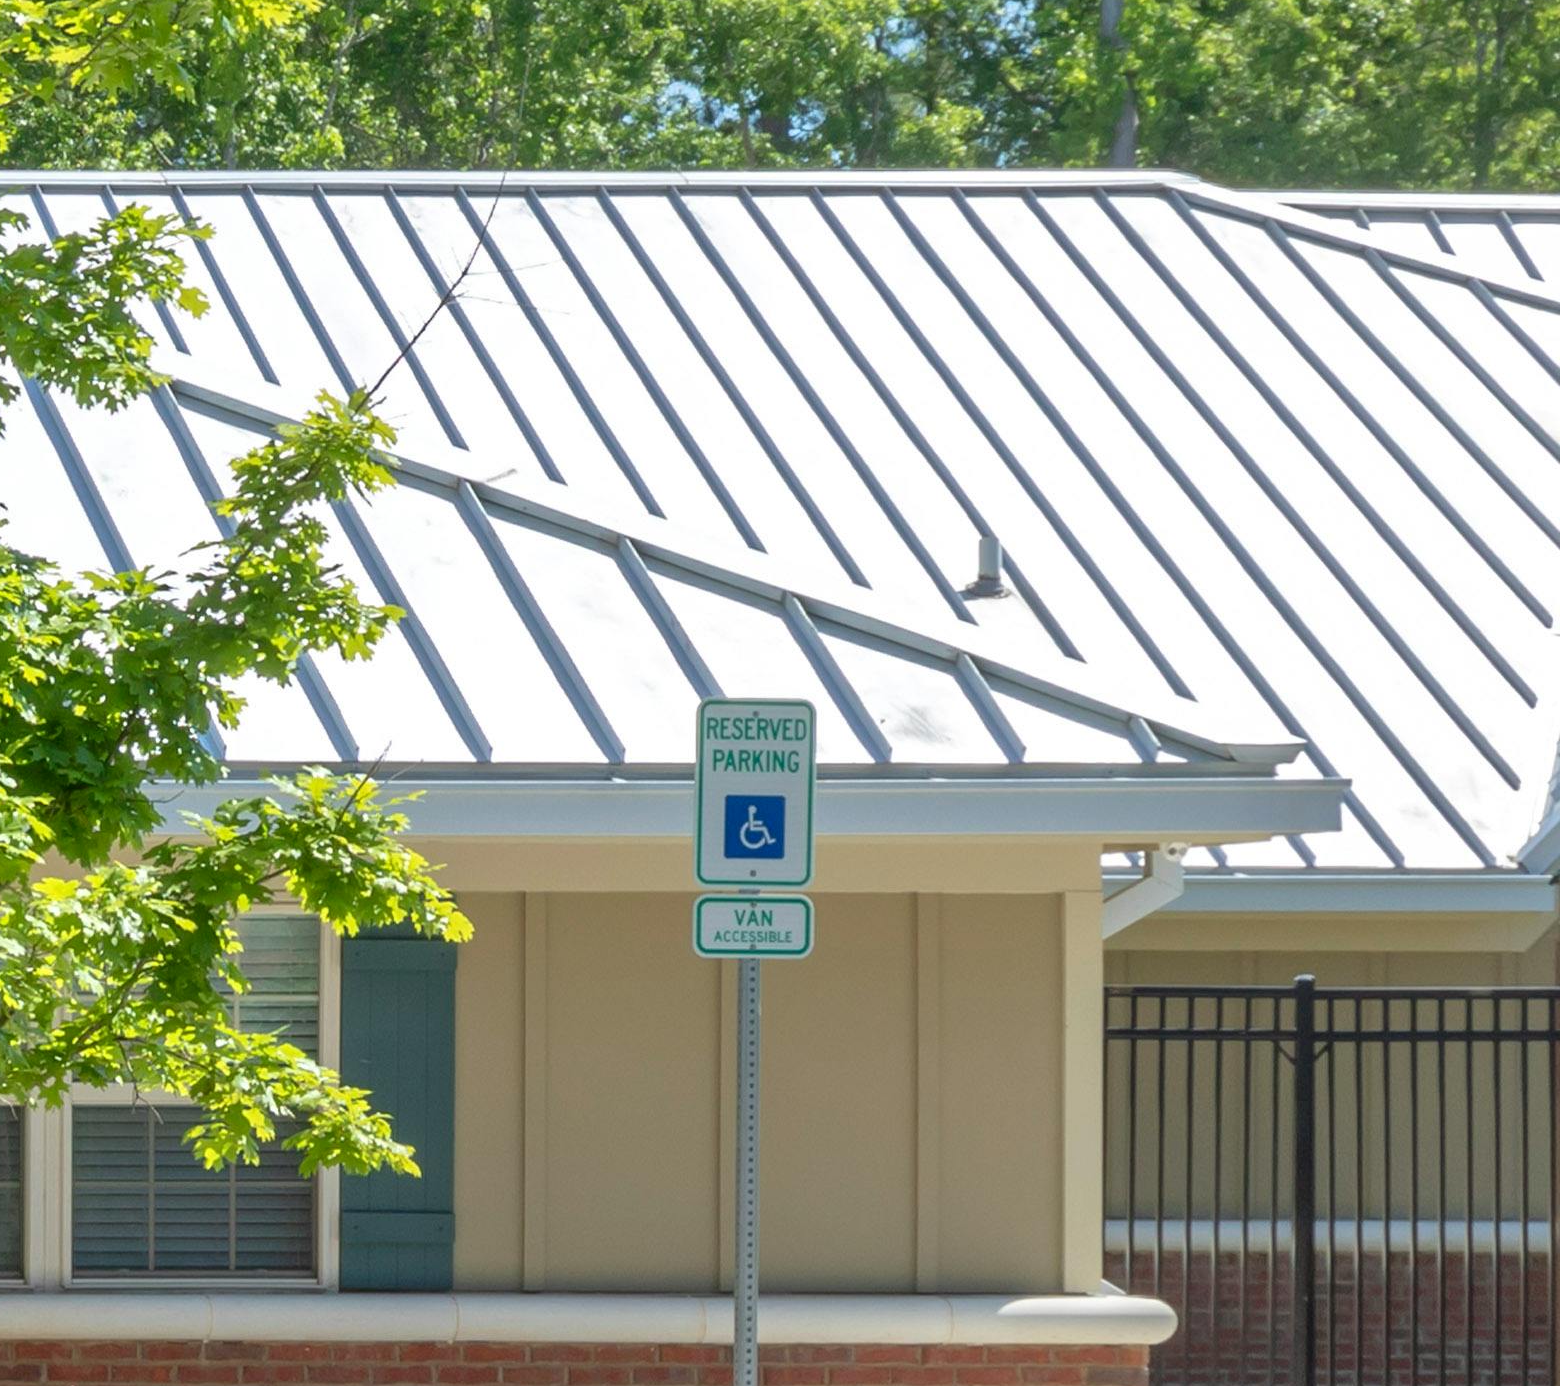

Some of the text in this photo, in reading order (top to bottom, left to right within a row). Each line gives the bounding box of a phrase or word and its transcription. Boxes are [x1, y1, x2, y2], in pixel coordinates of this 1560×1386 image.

[706, 717, 807, 741] RESERVED
[712, 749, 800, 773] PARKING
[735, 909, 773, 926] VAN
[713, 930, 792, 943] ACCESSIBLE
